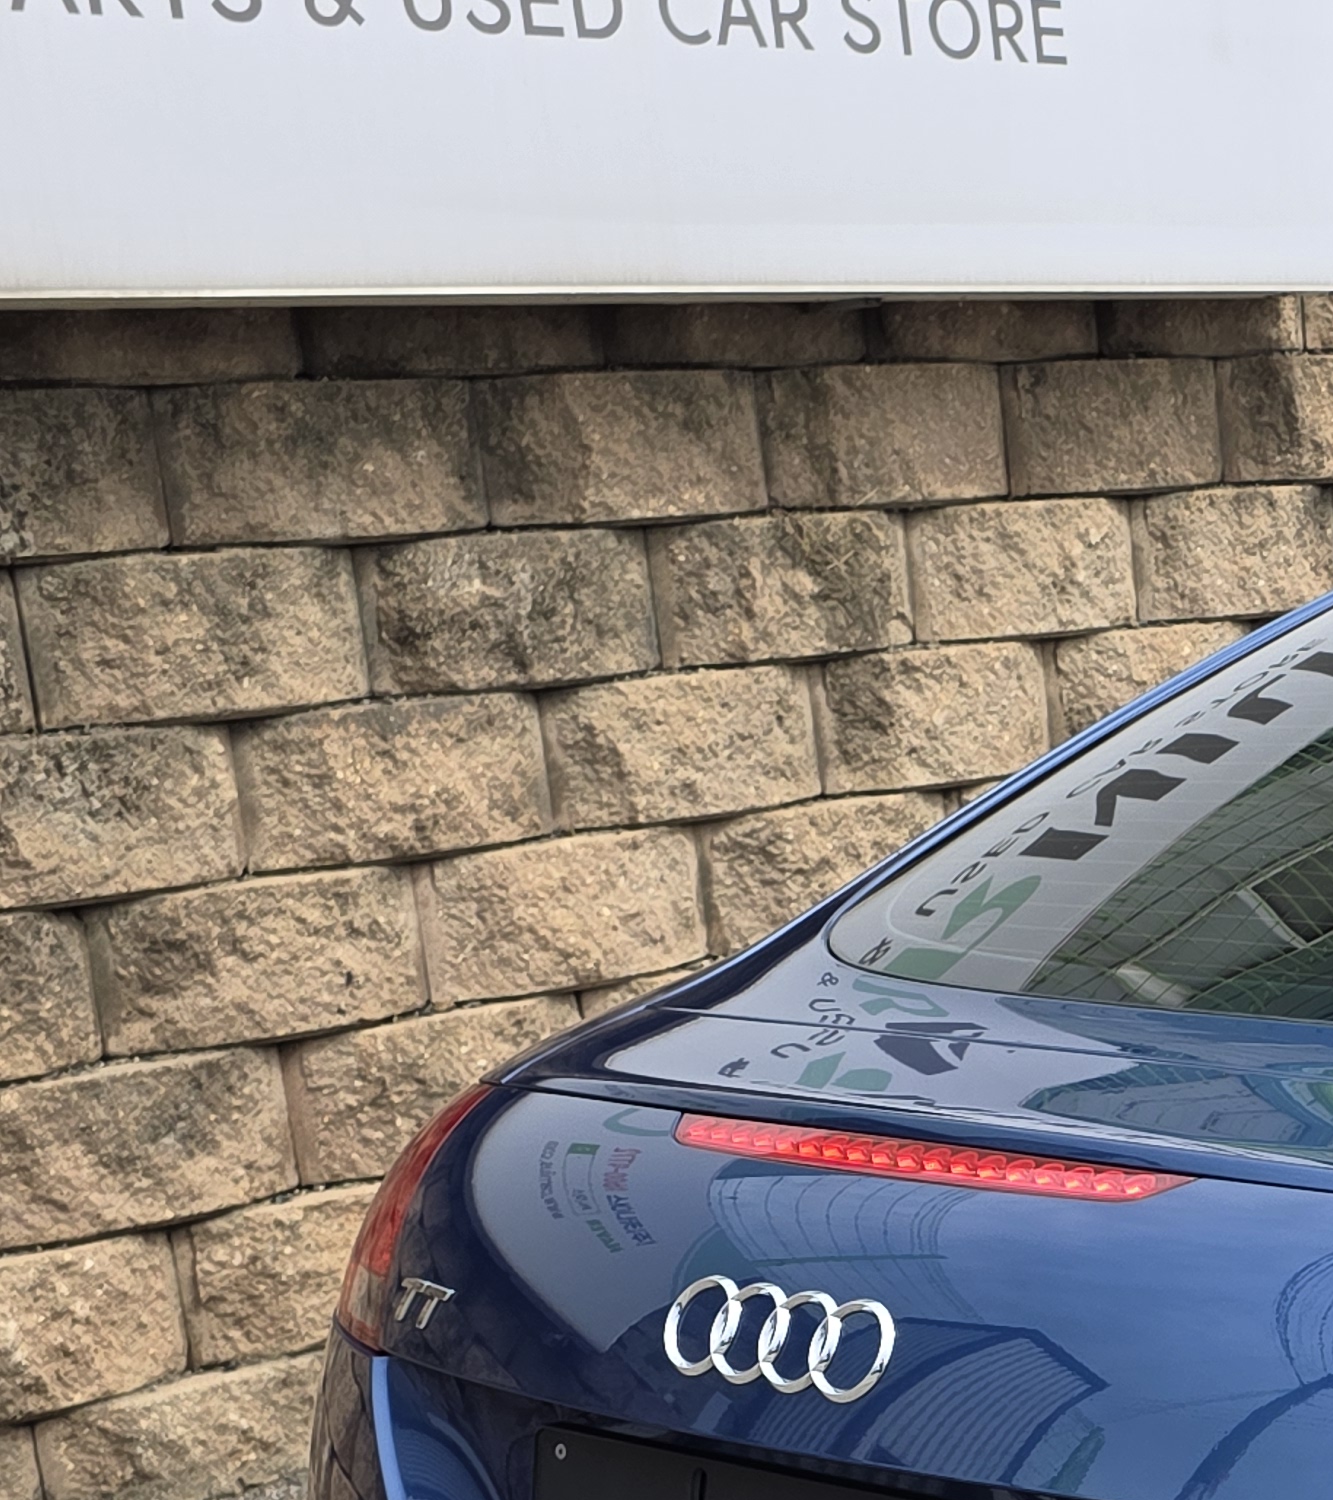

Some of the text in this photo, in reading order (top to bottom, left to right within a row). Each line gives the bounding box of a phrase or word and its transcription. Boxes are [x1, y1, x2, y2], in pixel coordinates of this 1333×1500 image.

[658, 0, 815, 51] CAR
[840, 0, 1069, 66] STORE
[393, 1276, 457, 1331] TT
